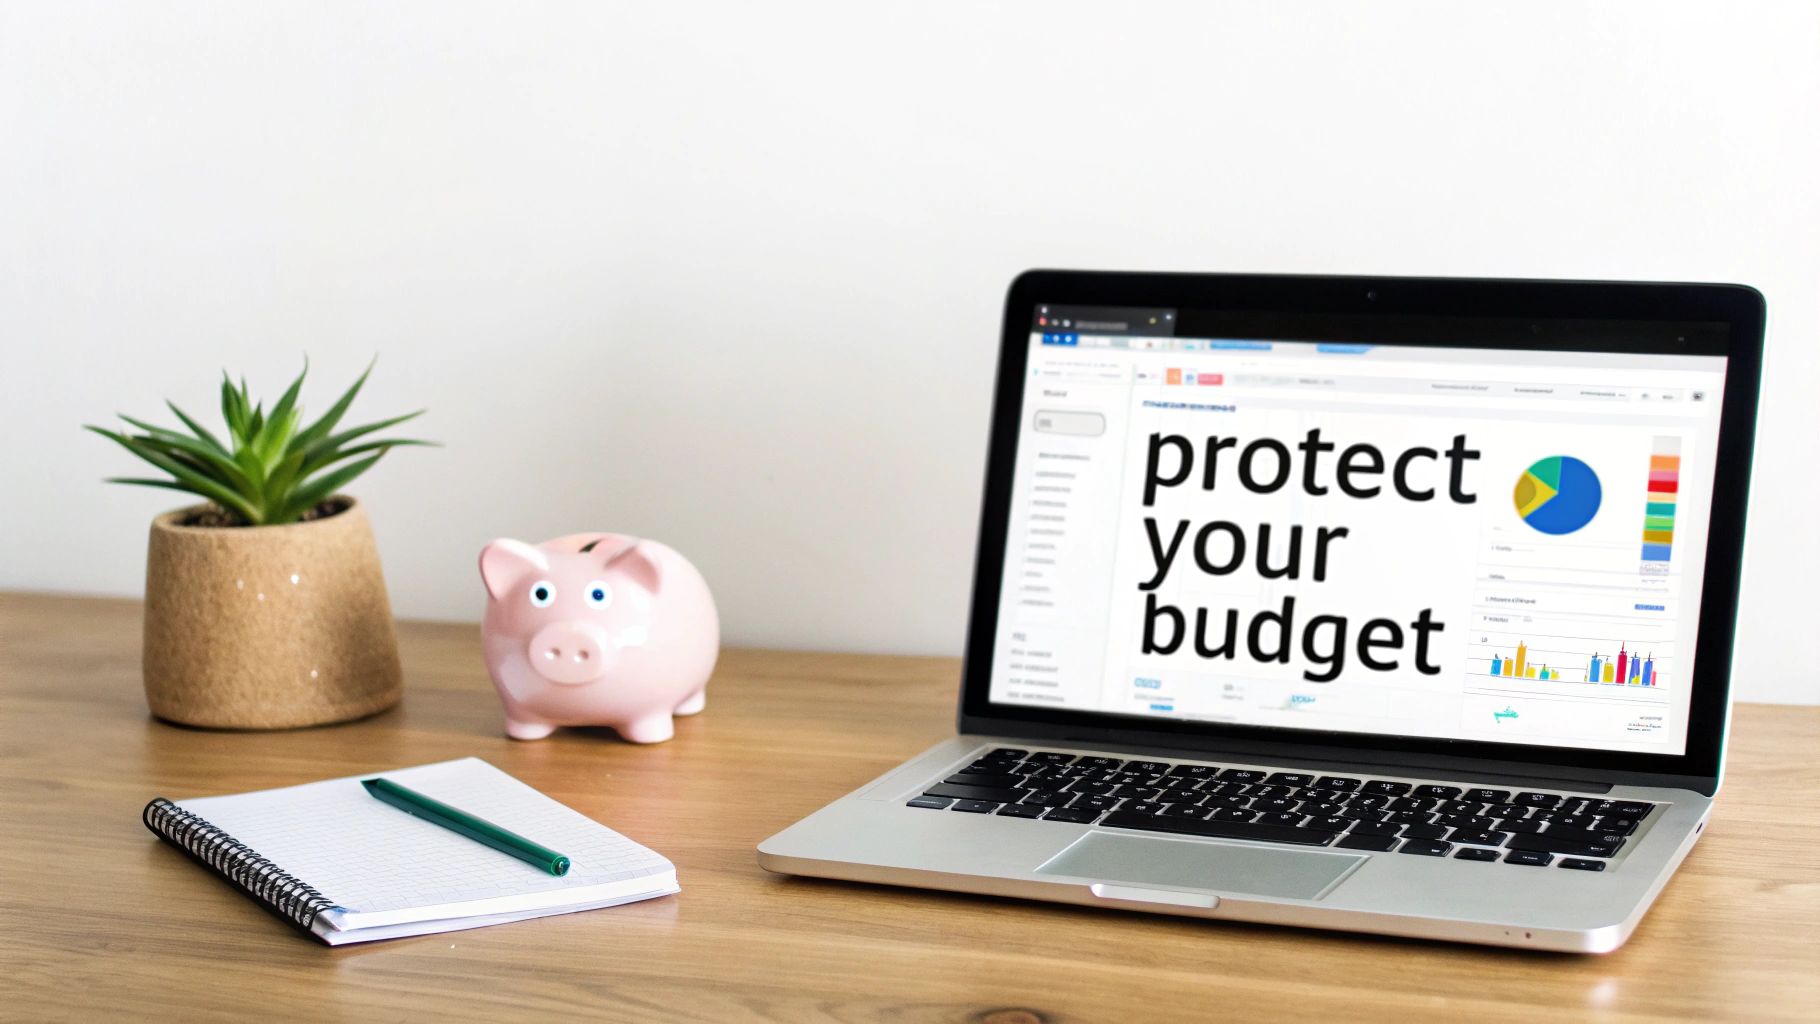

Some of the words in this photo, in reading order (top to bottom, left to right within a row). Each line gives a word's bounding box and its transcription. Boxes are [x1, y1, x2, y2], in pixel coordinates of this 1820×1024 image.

[1142, 428, 1481, 506] protect
[1138, 517, 1349, 590] your
[1141, 593, 1445, 682] budget
